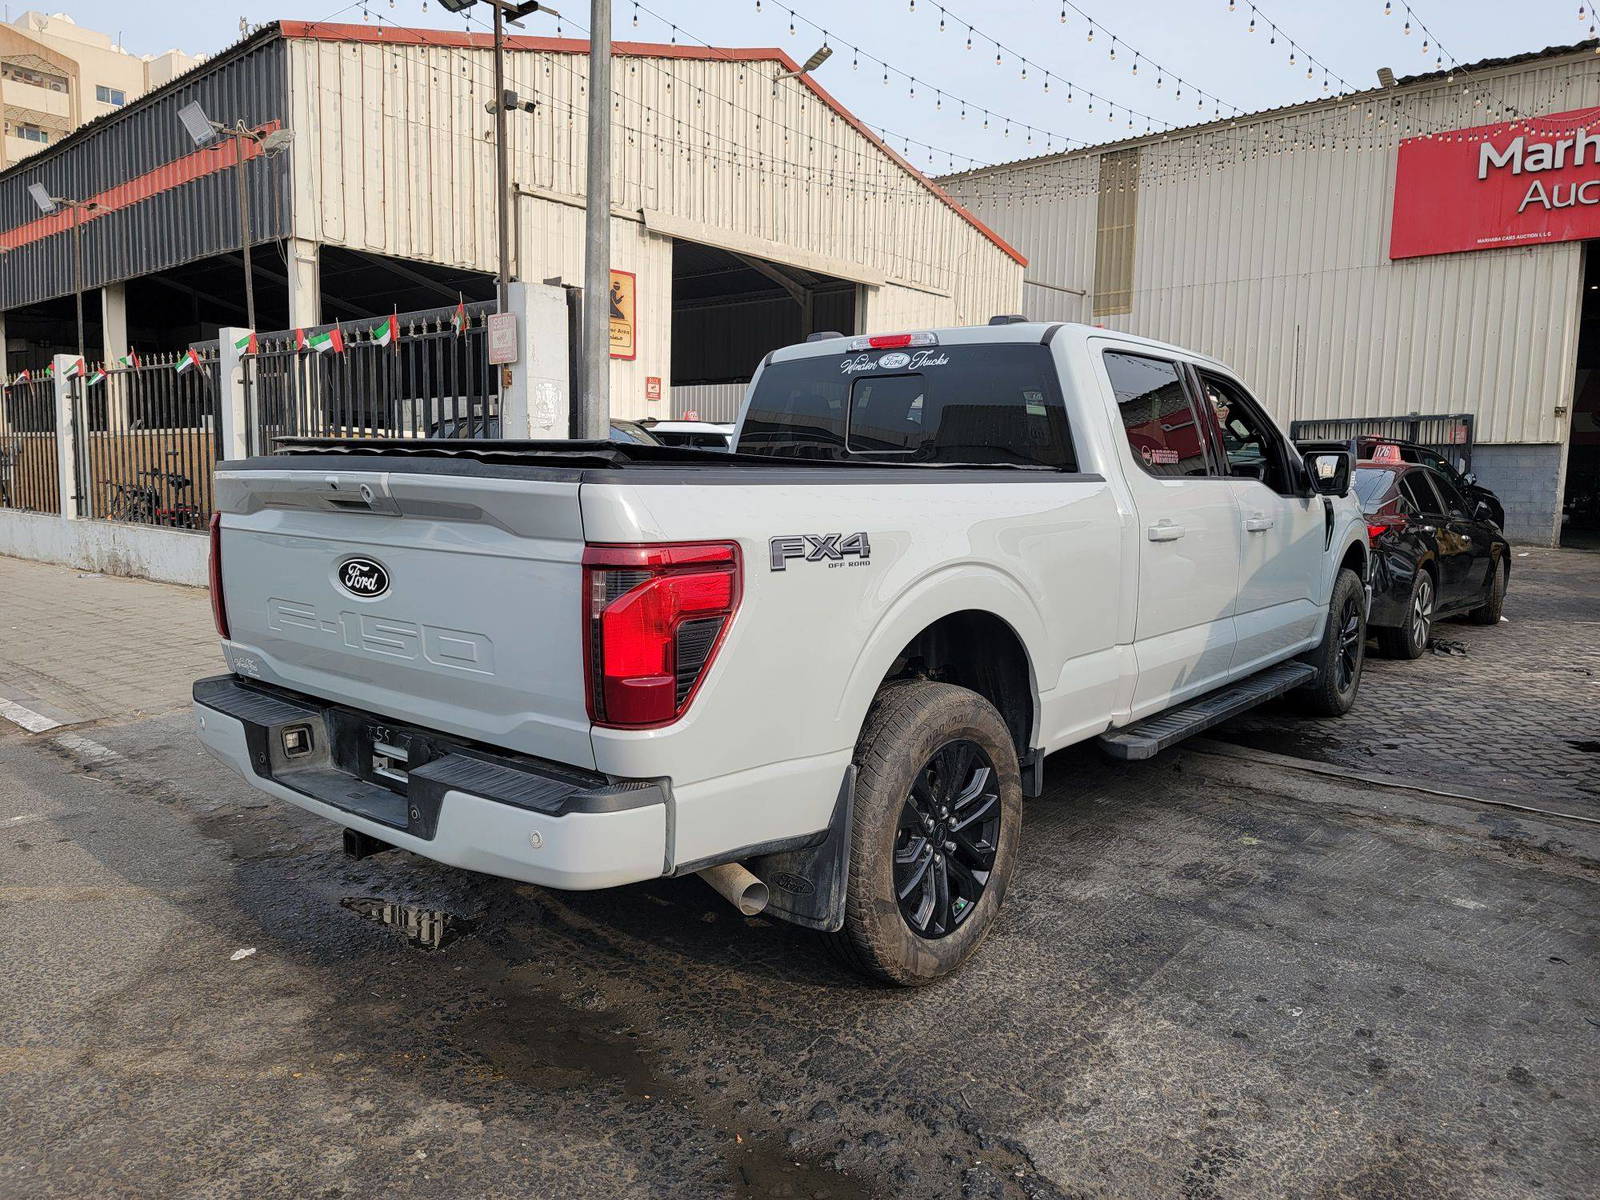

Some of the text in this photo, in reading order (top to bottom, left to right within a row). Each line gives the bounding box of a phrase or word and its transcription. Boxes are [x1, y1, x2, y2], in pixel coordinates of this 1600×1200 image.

[1478, 128, 1600, 179] Marh
[1517, 180, 1600, 213] Auc
[1516, 232, 1538, 240] AUCTION
[908, 349, 949, 370] Trucks
[1376, 446, 1389, 457] 176
[769, 532, 870, 572] FX4
[345, 563, 378, 591] Ford
[267, 597, 495, 676] F-150
